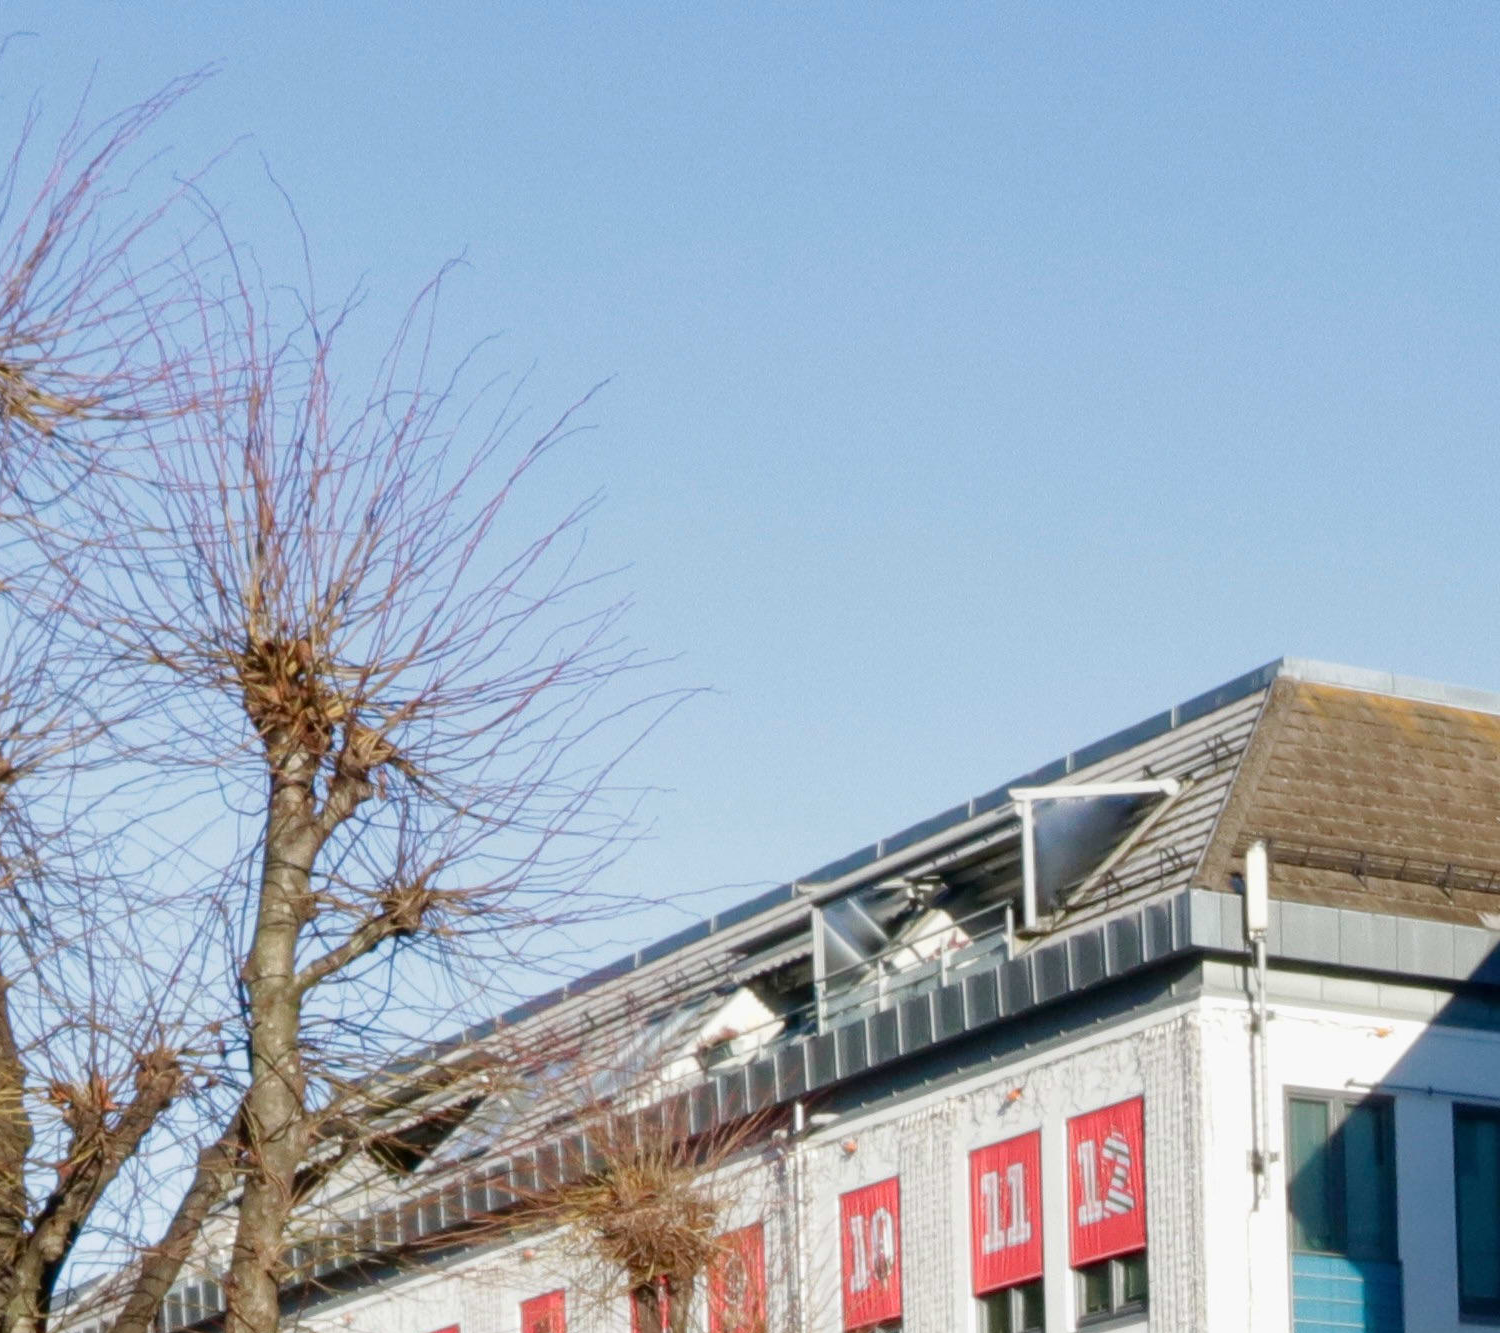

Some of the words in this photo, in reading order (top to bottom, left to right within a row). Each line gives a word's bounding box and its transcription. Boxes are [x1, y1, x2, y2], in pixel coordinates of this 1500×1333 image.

[980, 1162, 1032, 1255] 11
[1077, 1126, 1136, 1227] 12
[850, 1206, 894, 1293] 10
